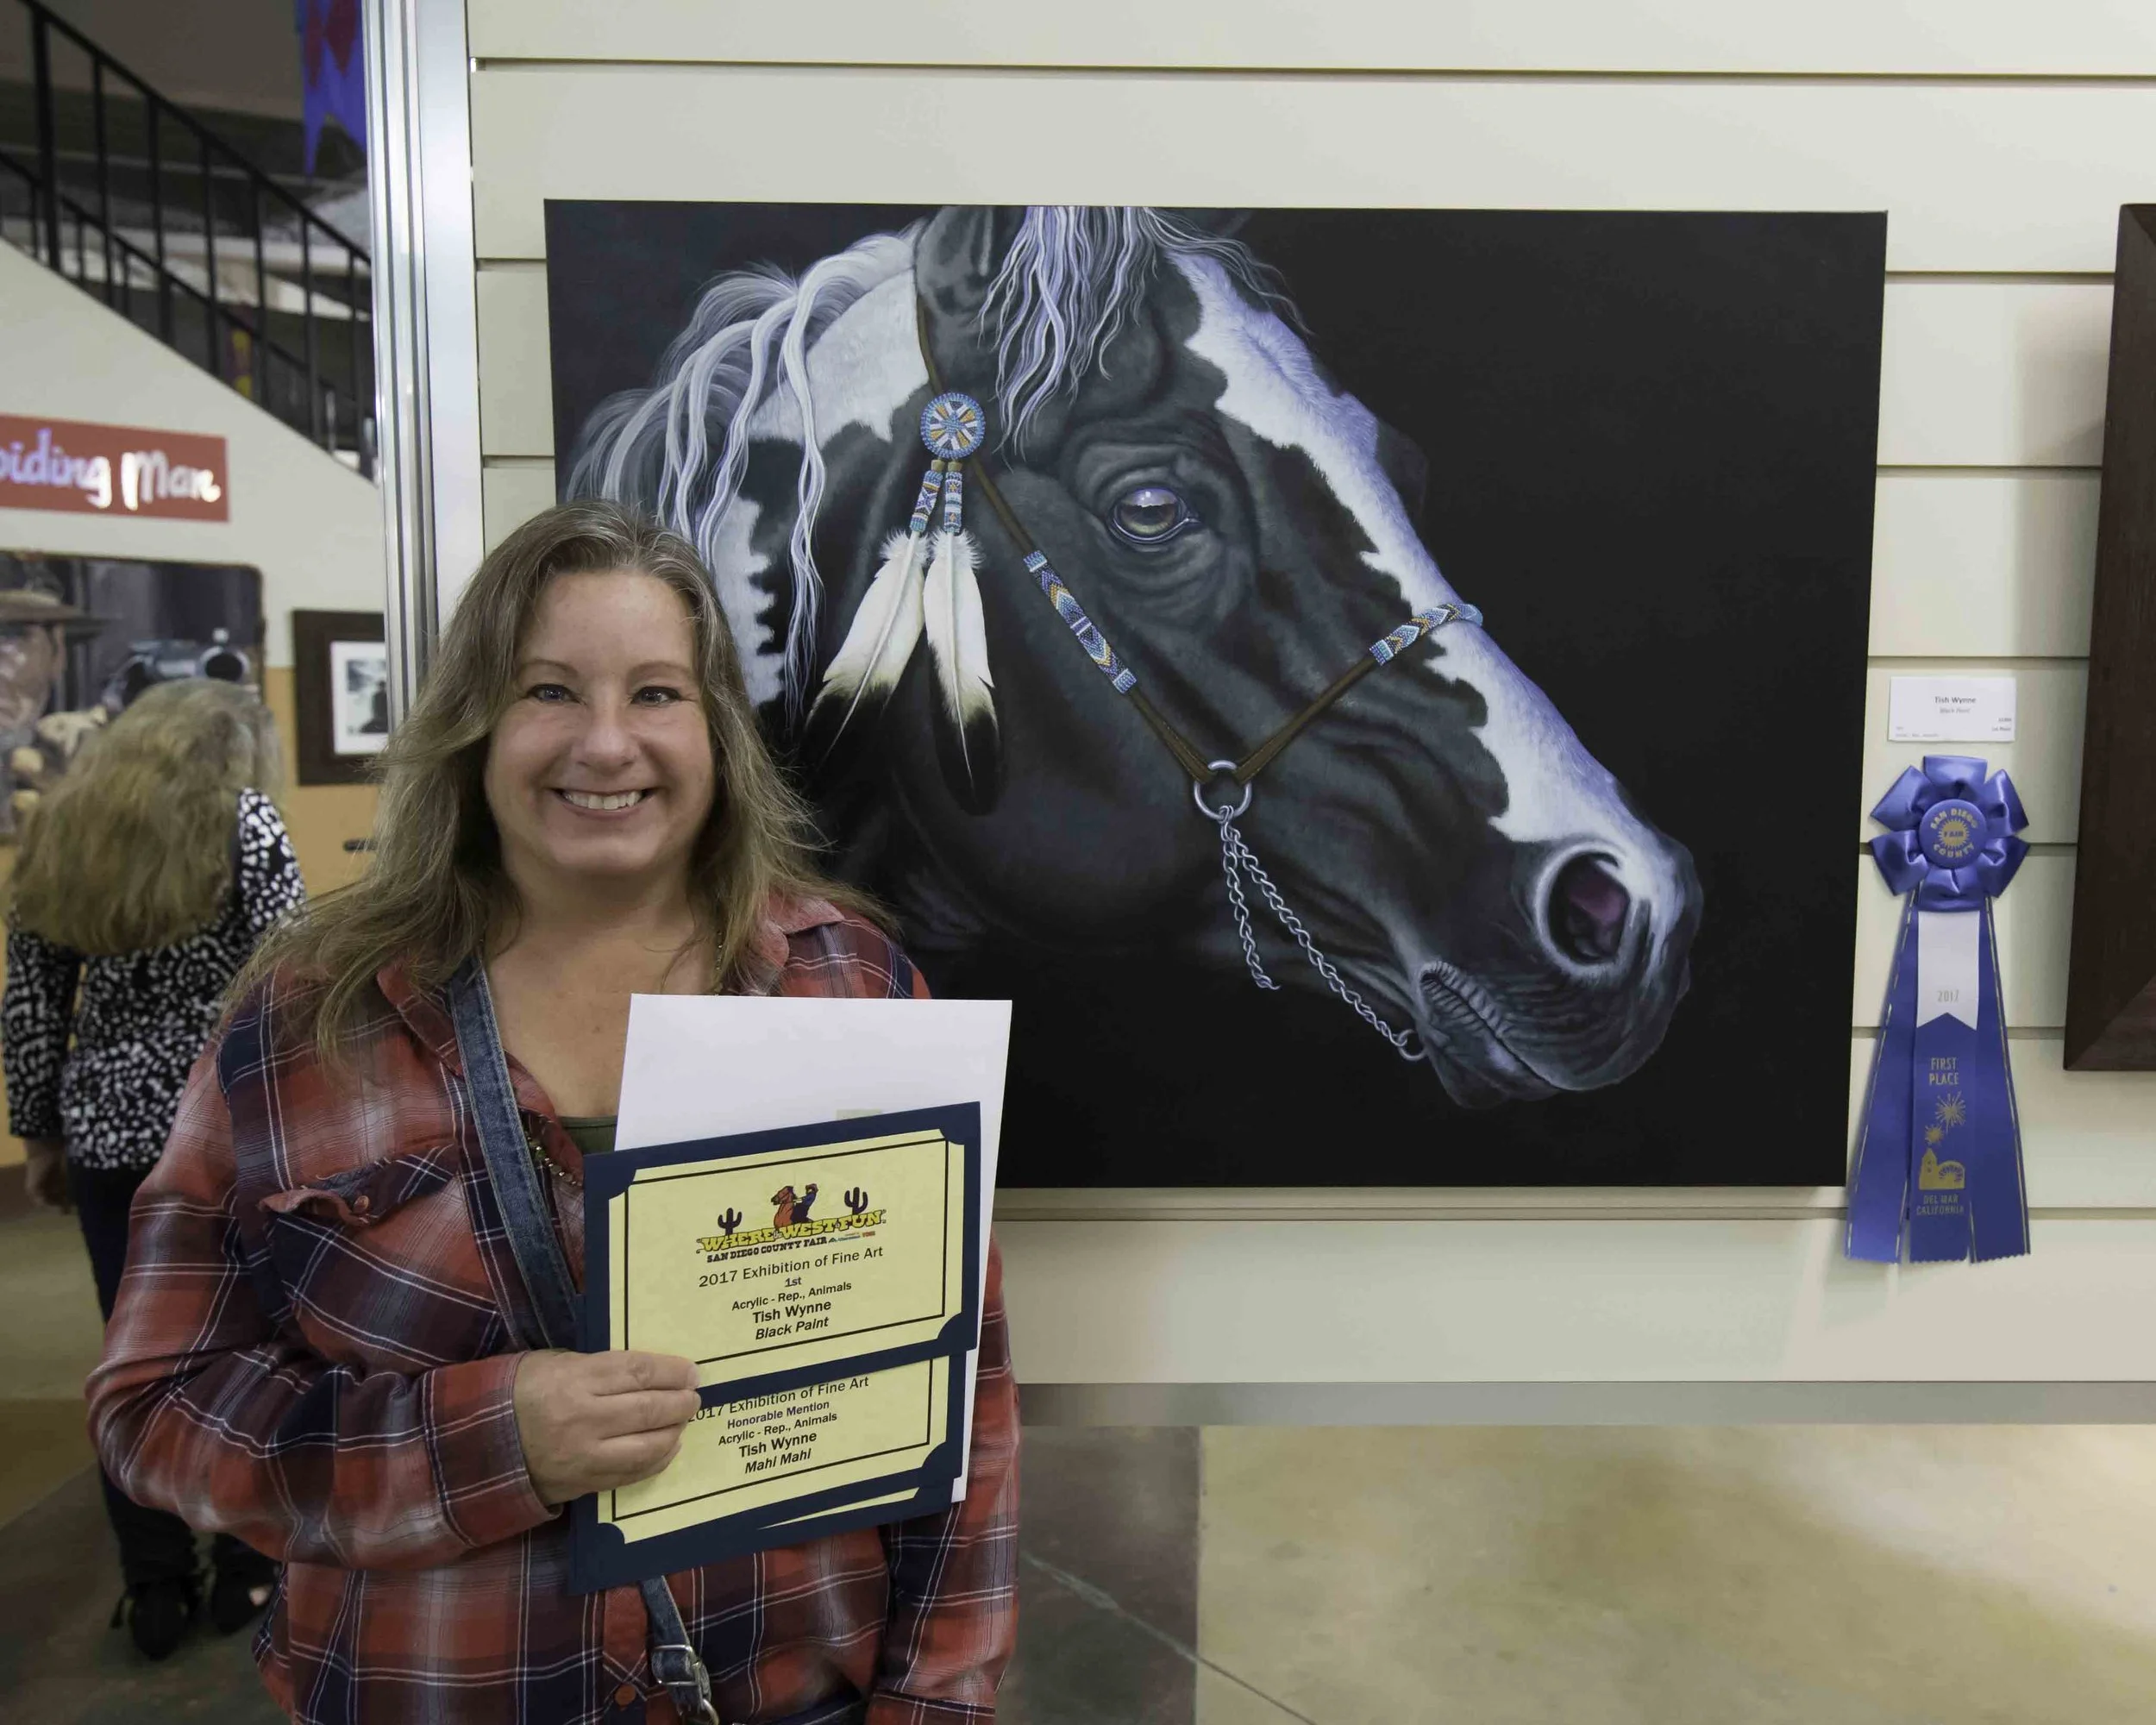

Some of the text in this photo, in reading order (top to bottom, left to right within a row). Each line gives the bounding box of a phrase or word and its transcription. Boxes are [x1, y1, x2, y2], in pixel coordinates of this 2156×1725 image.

[121, 449, 221, 511] Man
[1952, 696, 1977, 705] Wynne
[1930, 808, 1978, 829] SAN DIEGO
[1934, 843, 1974, 857] COUNTY
[1937, 989, 1959, 1002] 2017
[1931, 1057, 1958, 1070] FIRST
[1929, 1072, 1959, 1086] PLACE
[1916, 1205, 1965, 1215] CALIFORNIA
[1923, 1194, 1959, 1204] DEL MAR
[700, 1227, 776, 1251] WHERE
[780, 1218, 836, 1240] WEST
[838, 1209, 882, 1232] FUN
[707, 1251, 729, 1263] SAN
[730, 1247, 760, 1259] DIEGO
[761, 1242, 801, 1254] COUNTY
[804, 1236, 827, 1248] FAIR
[699, 1246, 883, 1288] 2017 Exhibition of Fine Art
[785, 1276, 802, 1287] 1st
[731, 1296, 768, 1312] Acrylic
[778, 1292, 805, 1304] Rep.,
[808, 1282, 852, 1297] Animals
[752, 1301, 831, 1324] Tish Wynne
[755, 1316, 829, 1340] Black Paint
[730, 1393, 796, 1414] Exhibition
[800, 1385, 813, 1399] of
[818, 1382, 845, 1396] Fine
[849, 1376, 869, 1389] Art
[727, 1402, 830, 1429] Honorable Mention
[718, 1429, 755, 1446] Acrylic
[764, 1424, 791, 1438] Rep.,
[794, 1413, 837, 1429] Animals
[739, 1432, 818, 1458] Tish Wynne
